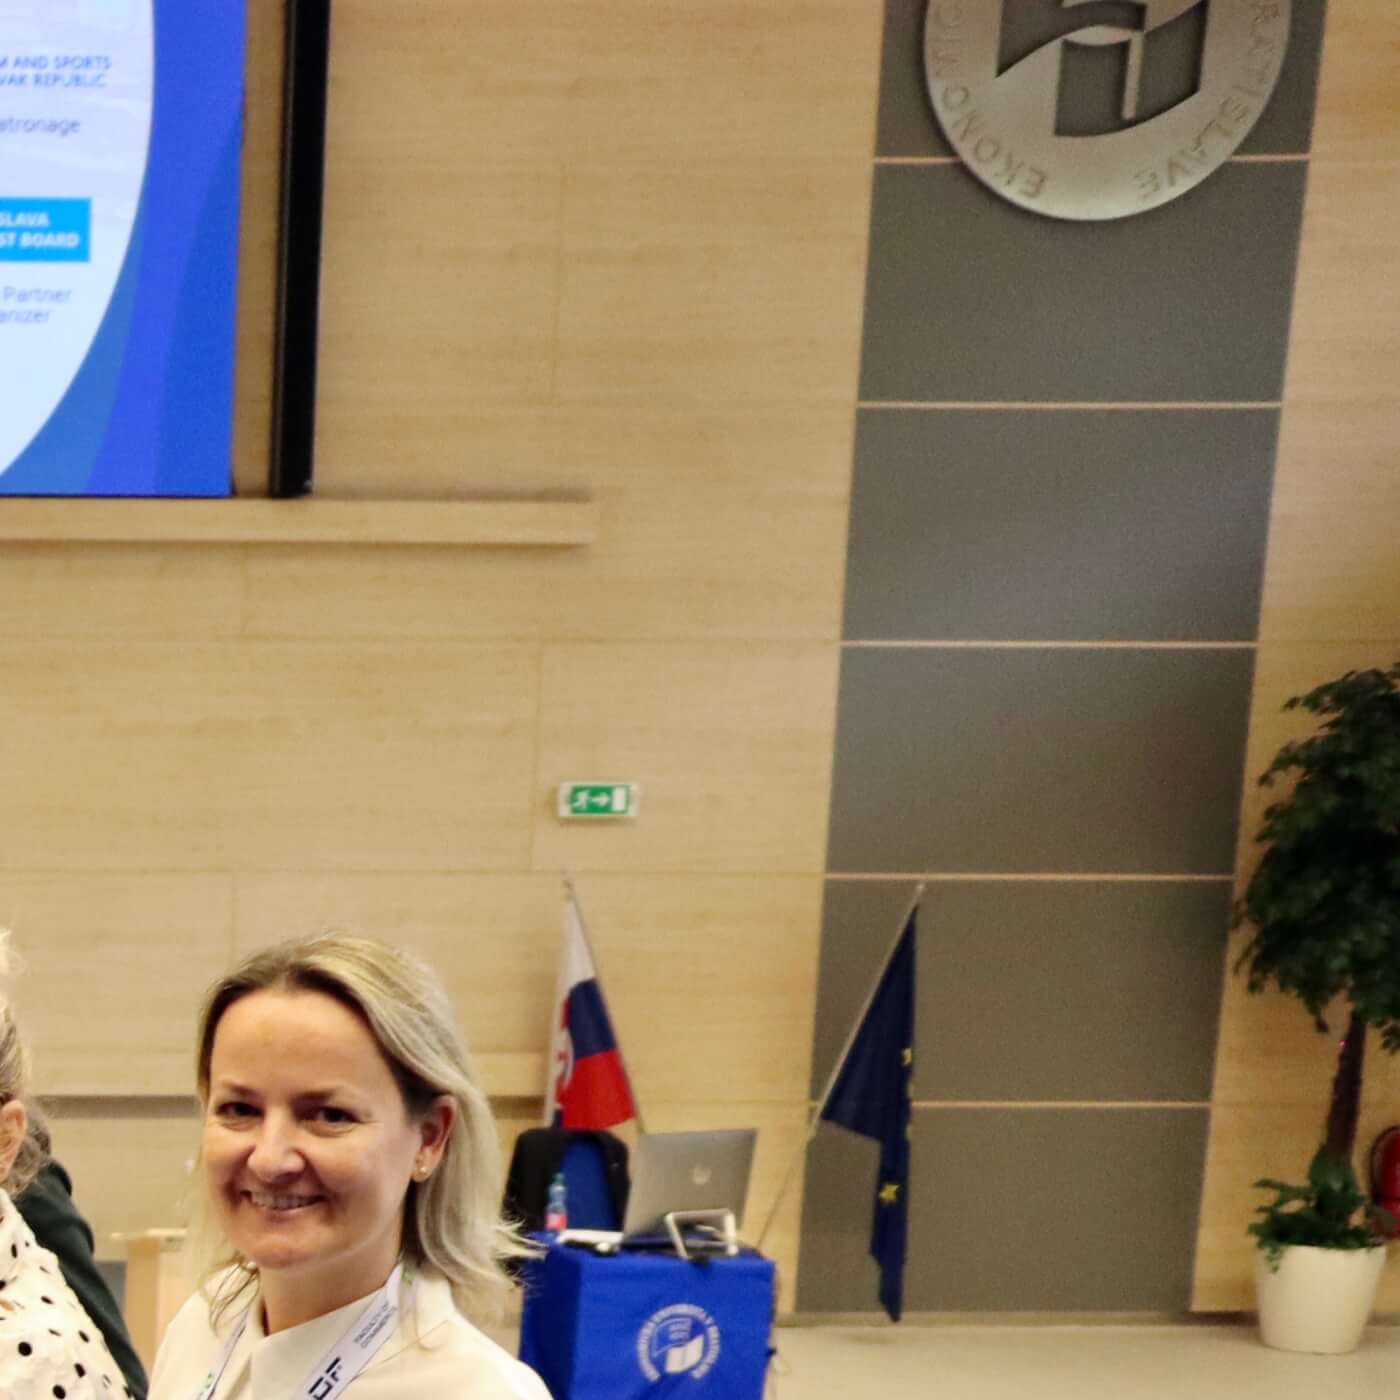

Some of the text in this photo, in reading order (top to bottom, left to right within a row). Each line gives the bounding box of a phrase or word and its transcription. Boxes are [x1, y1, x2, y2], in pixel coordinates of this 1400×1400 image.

[12, 55, 49, 70] AND
[53, 54, 112, 70] SPORTS
[33, 72, 106, 88] REPUBLIC
[20, 231, 80, 248] BOARD
[3, 286, 72, 303] Partner
